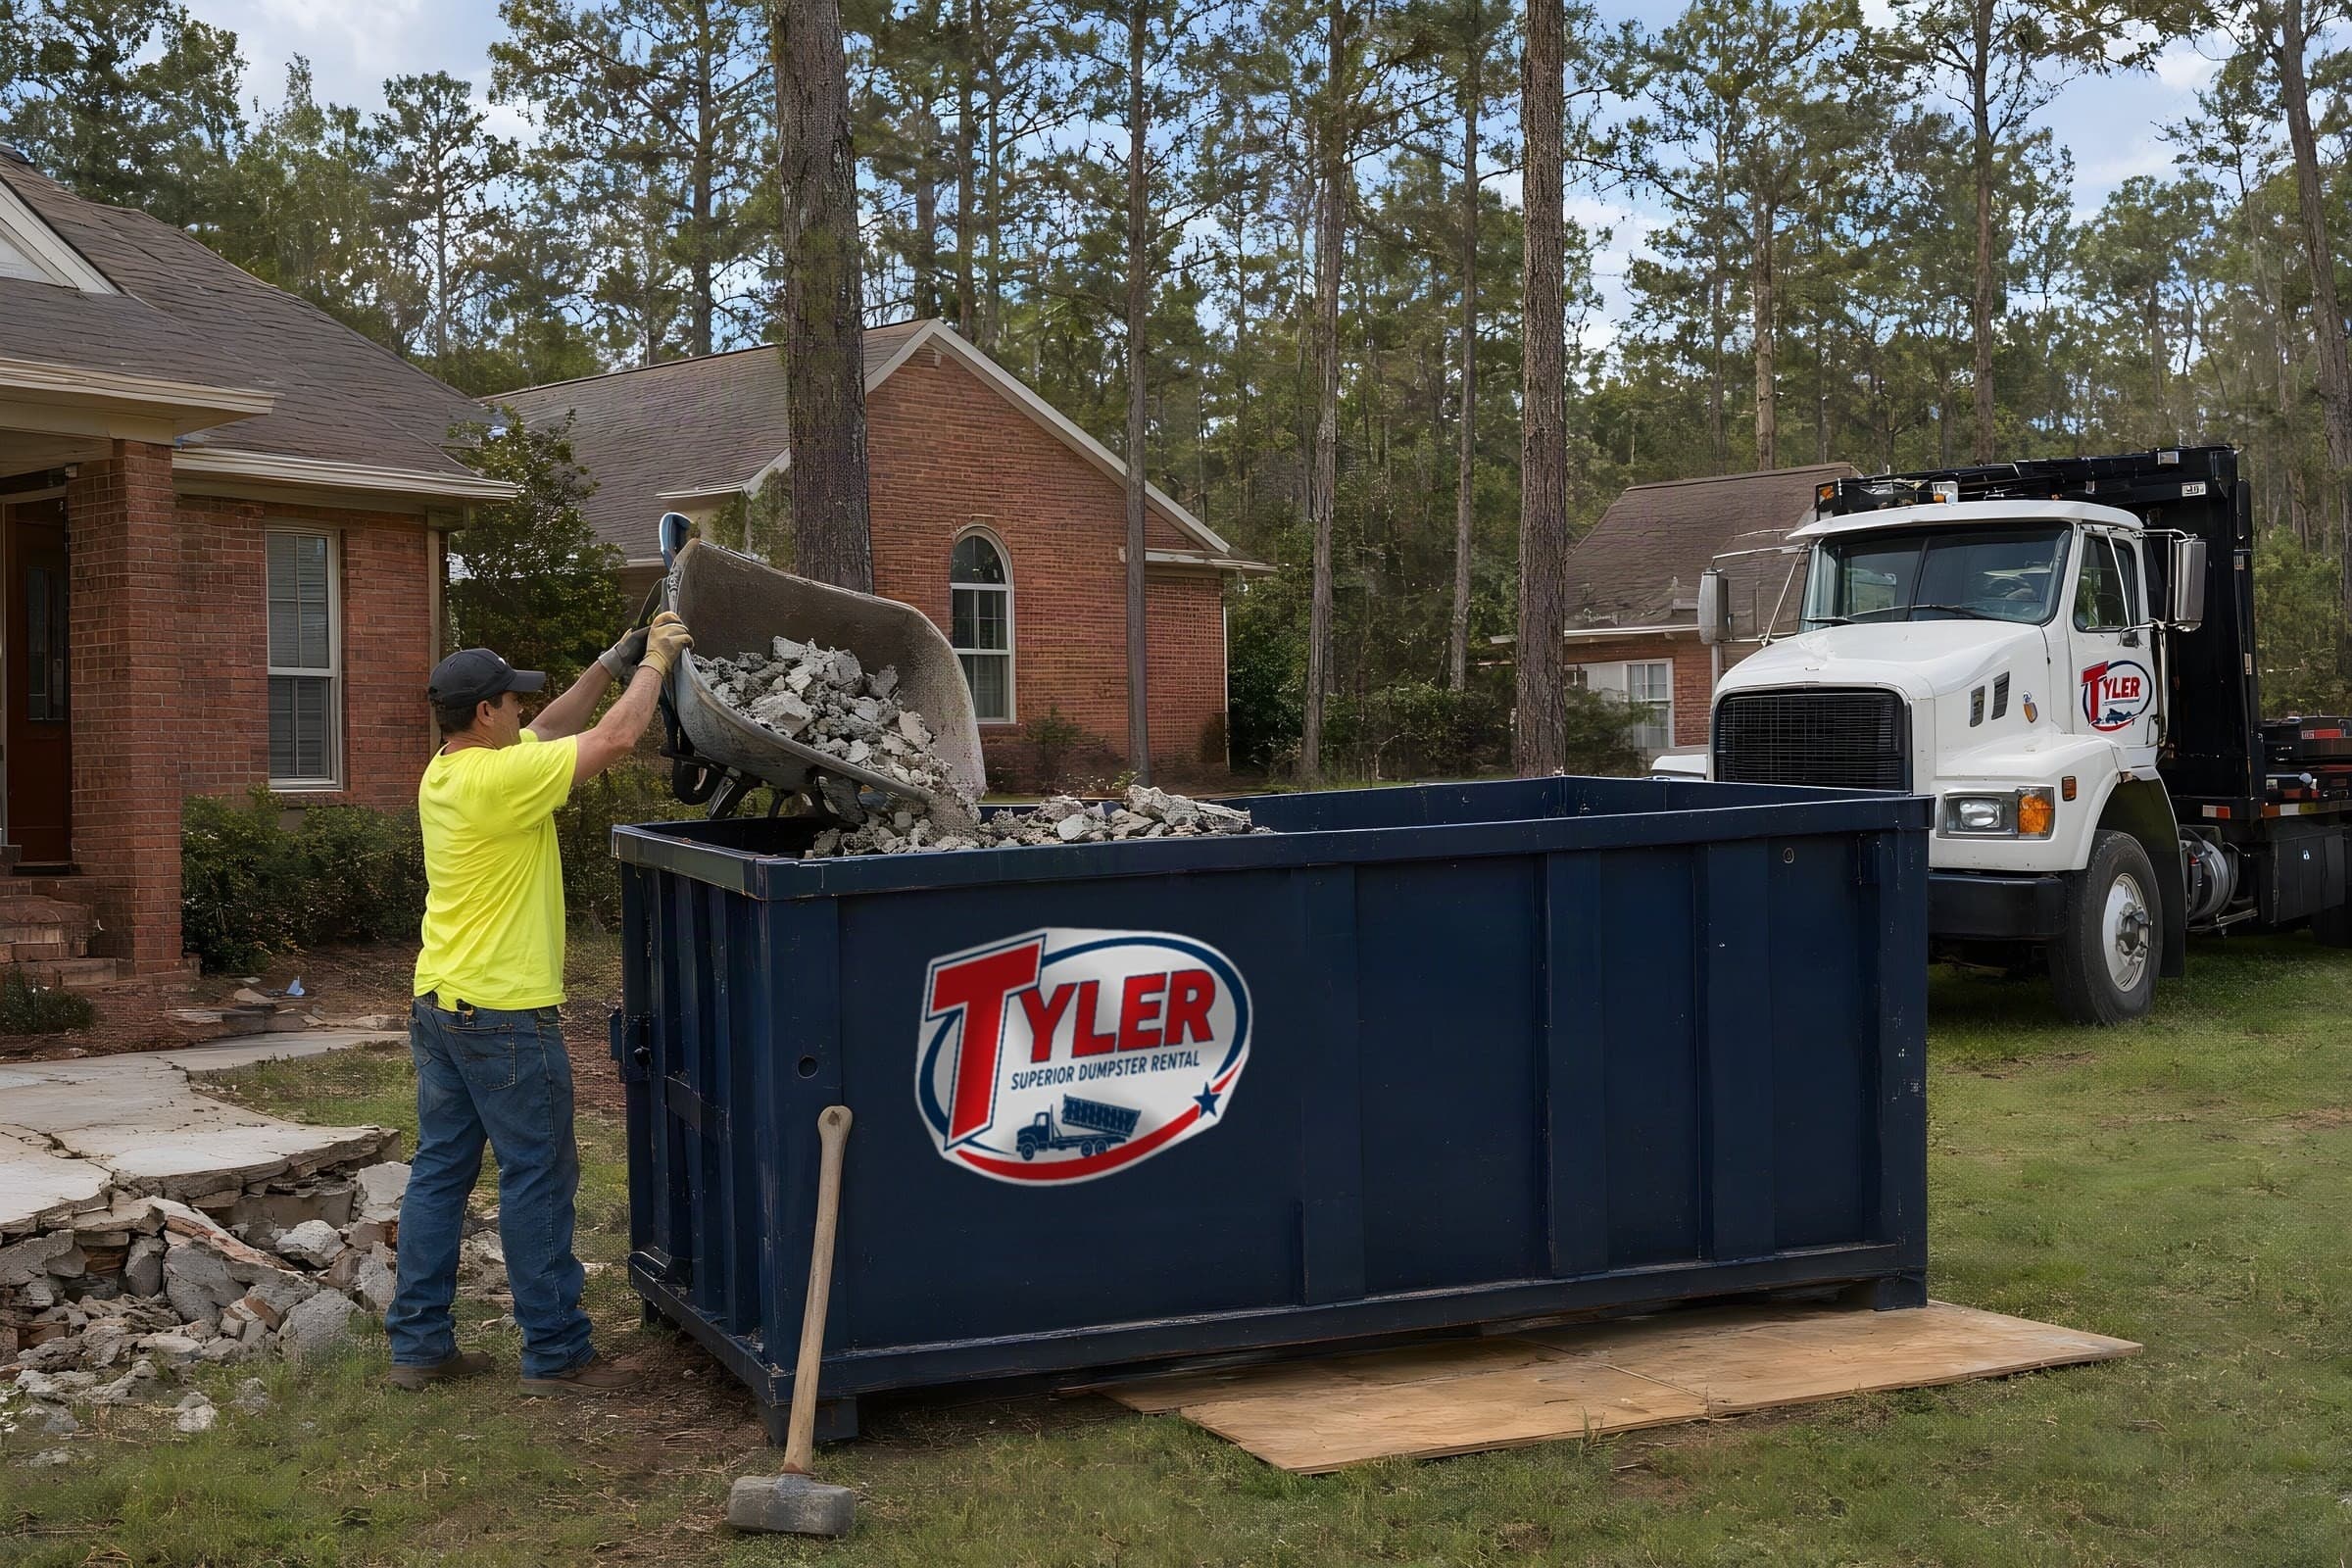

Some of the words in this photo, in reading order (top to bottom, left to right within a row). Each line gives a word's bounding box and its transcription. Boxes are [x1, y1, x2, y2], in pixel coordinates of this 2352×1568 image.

[2081, 662, 2141, 724] TYLER
[928, 936, 1216, 1147] TYLER
[1011, 1065, 1075, 1090] SUPERIOR
[1078, 1055, 1148, 1081] DUMPSTER
[1151, 1051, 1200, 1072] RENTAL
